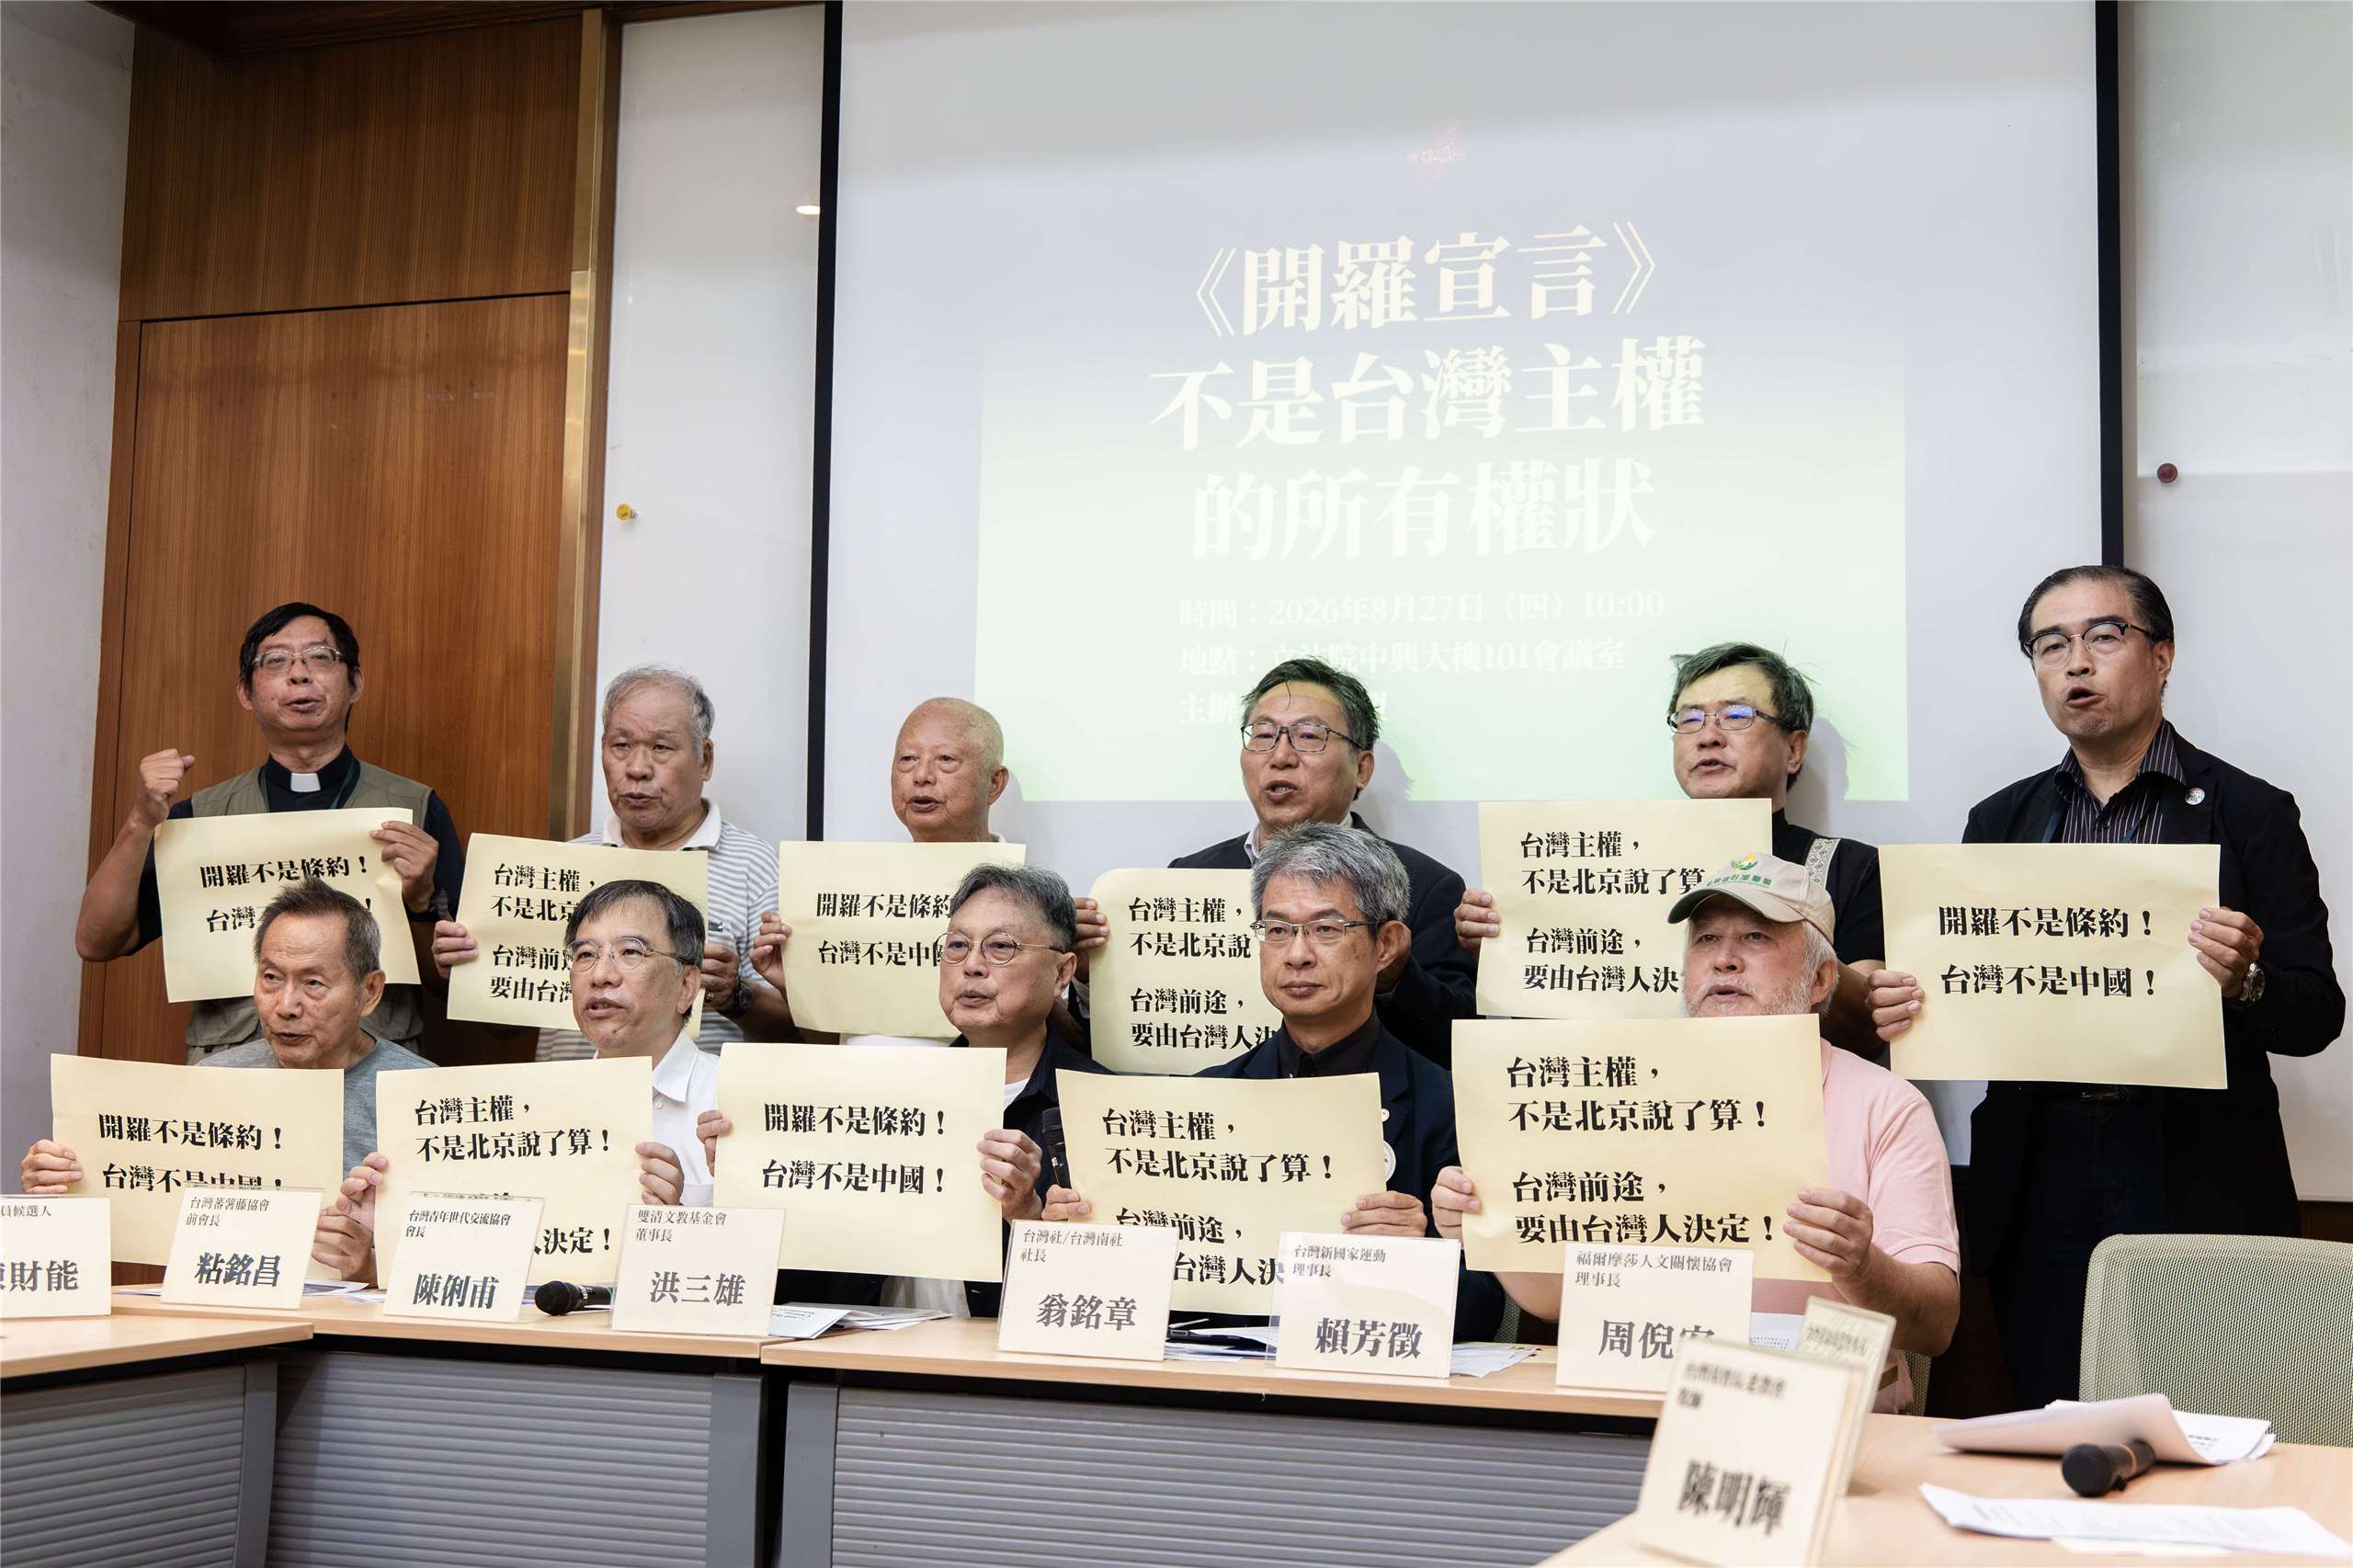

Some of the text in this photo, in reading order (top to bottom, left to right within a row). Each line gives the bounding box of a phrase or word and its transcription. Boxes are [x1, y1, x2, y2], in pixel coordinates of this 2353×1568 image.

[1197, 222, 1655, 335] 《開羅宣言》
[1149, 335, 1707, 451] 不是台灣主權
[1195, 458, 1657, 561] 的所有權狀
[1520, 831, 1639, 858] 台灣主權，
[199, 856, 368, 889] 開羅不是條約！
[494, 863, 596, 892] 台灣主權，
[1521, 868, 1705, 895] 不是北京說了算
[816, 892, 951, 919] 開羅不是條約
[1129, 897, 1242, 923] 台灣主權，
[1938, 906, 2152, 937] 開羅不是條約！
[1129, 931, 1251, 959] 不是北京說
[1527, 927, 1641, 955] 台灣前途，
[1523, 964, 1679, 993] 要由台灣人決
[1941, 963, 2154, 997] 台灣不是中國！
[1131, 987, 1244, 1015] 台灣前途，
[1507, 1056, 1658, 1087] 台灣主權，
[415, 1095, 530, 1126] 台灣主權，
[765, 1103, 944, 1136] 開羅不是條約！
[1103, 1108, 1234, 1141] 台灣主權，
[1507, 1098, 1765, 1131] 不是北京說了算！
[98, 1114, 281, 1150] 開羅不是條約！
[415, 1128, 608, 1162] 不是北京說了算！
[763, 1159, 944, 1194] 台灣不是中國！
[1105, 1147, 1332, 1183] 不是北京說了算！
[1513, 1171, 1666, 1202] 台灣前途，
[186, 1212, 221, 1226] 前會長
[405, 1225, 426, 1237] 會長
[410, 1210, 511, 1226] 台灣青年世代交流協會
[638, 1210, 726, 1226] 雙清文教基金會
[1516, 1213, 1773, 1244] 要由台灣人決定！
[636, 1228, 673, 1242] 董事長
[1023, 1229, 1123, 1247] 台灣社/台灣南社
[1020, 1248, 1047, 1263] 社長
[1294, 1244, 1386, 1263] 台灣新國家運動
[1576, 1251, 1733, 1272] 福爾摩莎人文關懷協會
[0, 1259, 79, 1292] 財能
[194, 1252, 280, 1287] 粘銘昌
[1292, 1263, 1331, 1278] 理事長
[1574, 1271, 1621, 1288] 理事長
[413, 1273, 499, 1309] 陳俐甫
[650, 1270, 746, 1306] 洪三雄
[1037, 1294, 1137, 1331] 翁銘章
[1314, 1317, 1424, 1359] 賴芳徵
